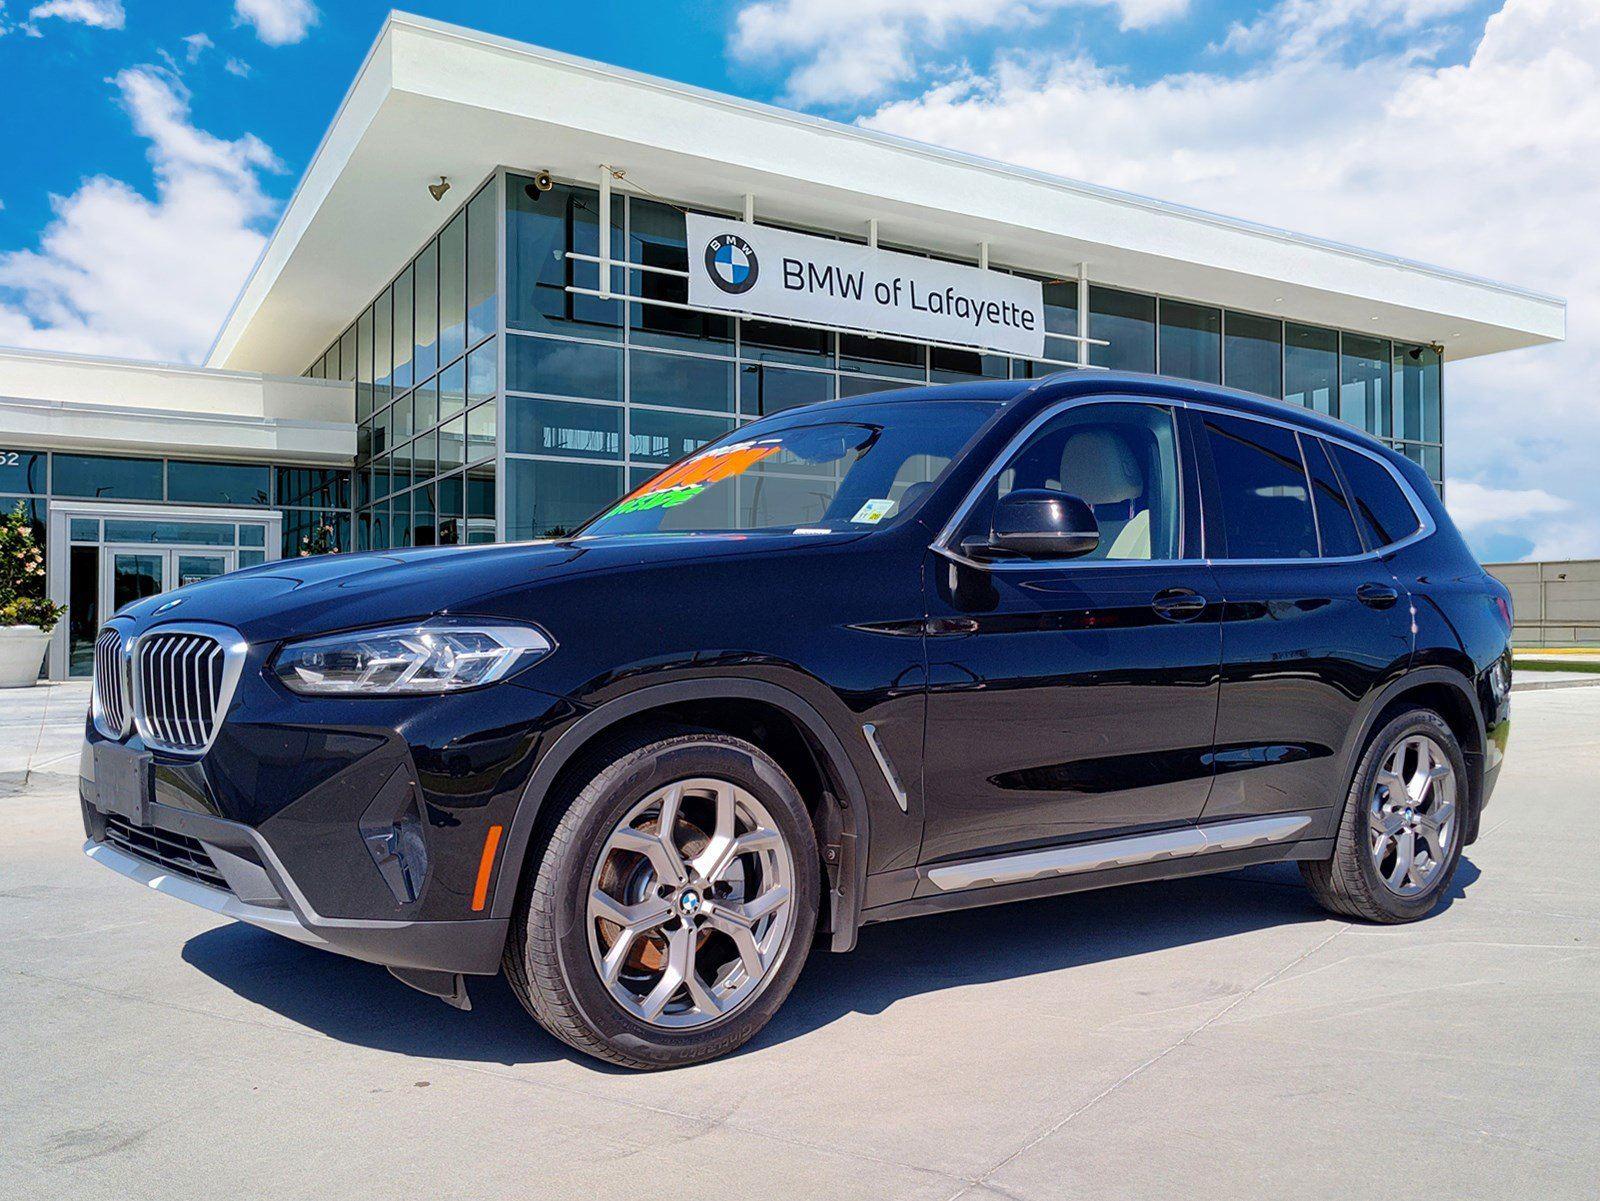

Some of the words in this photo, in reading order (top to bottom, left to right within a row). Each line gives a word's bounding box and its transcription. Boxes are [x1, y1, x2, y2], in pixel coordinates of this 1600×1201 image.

[710, 235, 753, 256] BMW
[782, 257, 865, 301] BMW
[874, 277, 902, 306] of
[910, 280, 1035, 331] Lafayette
